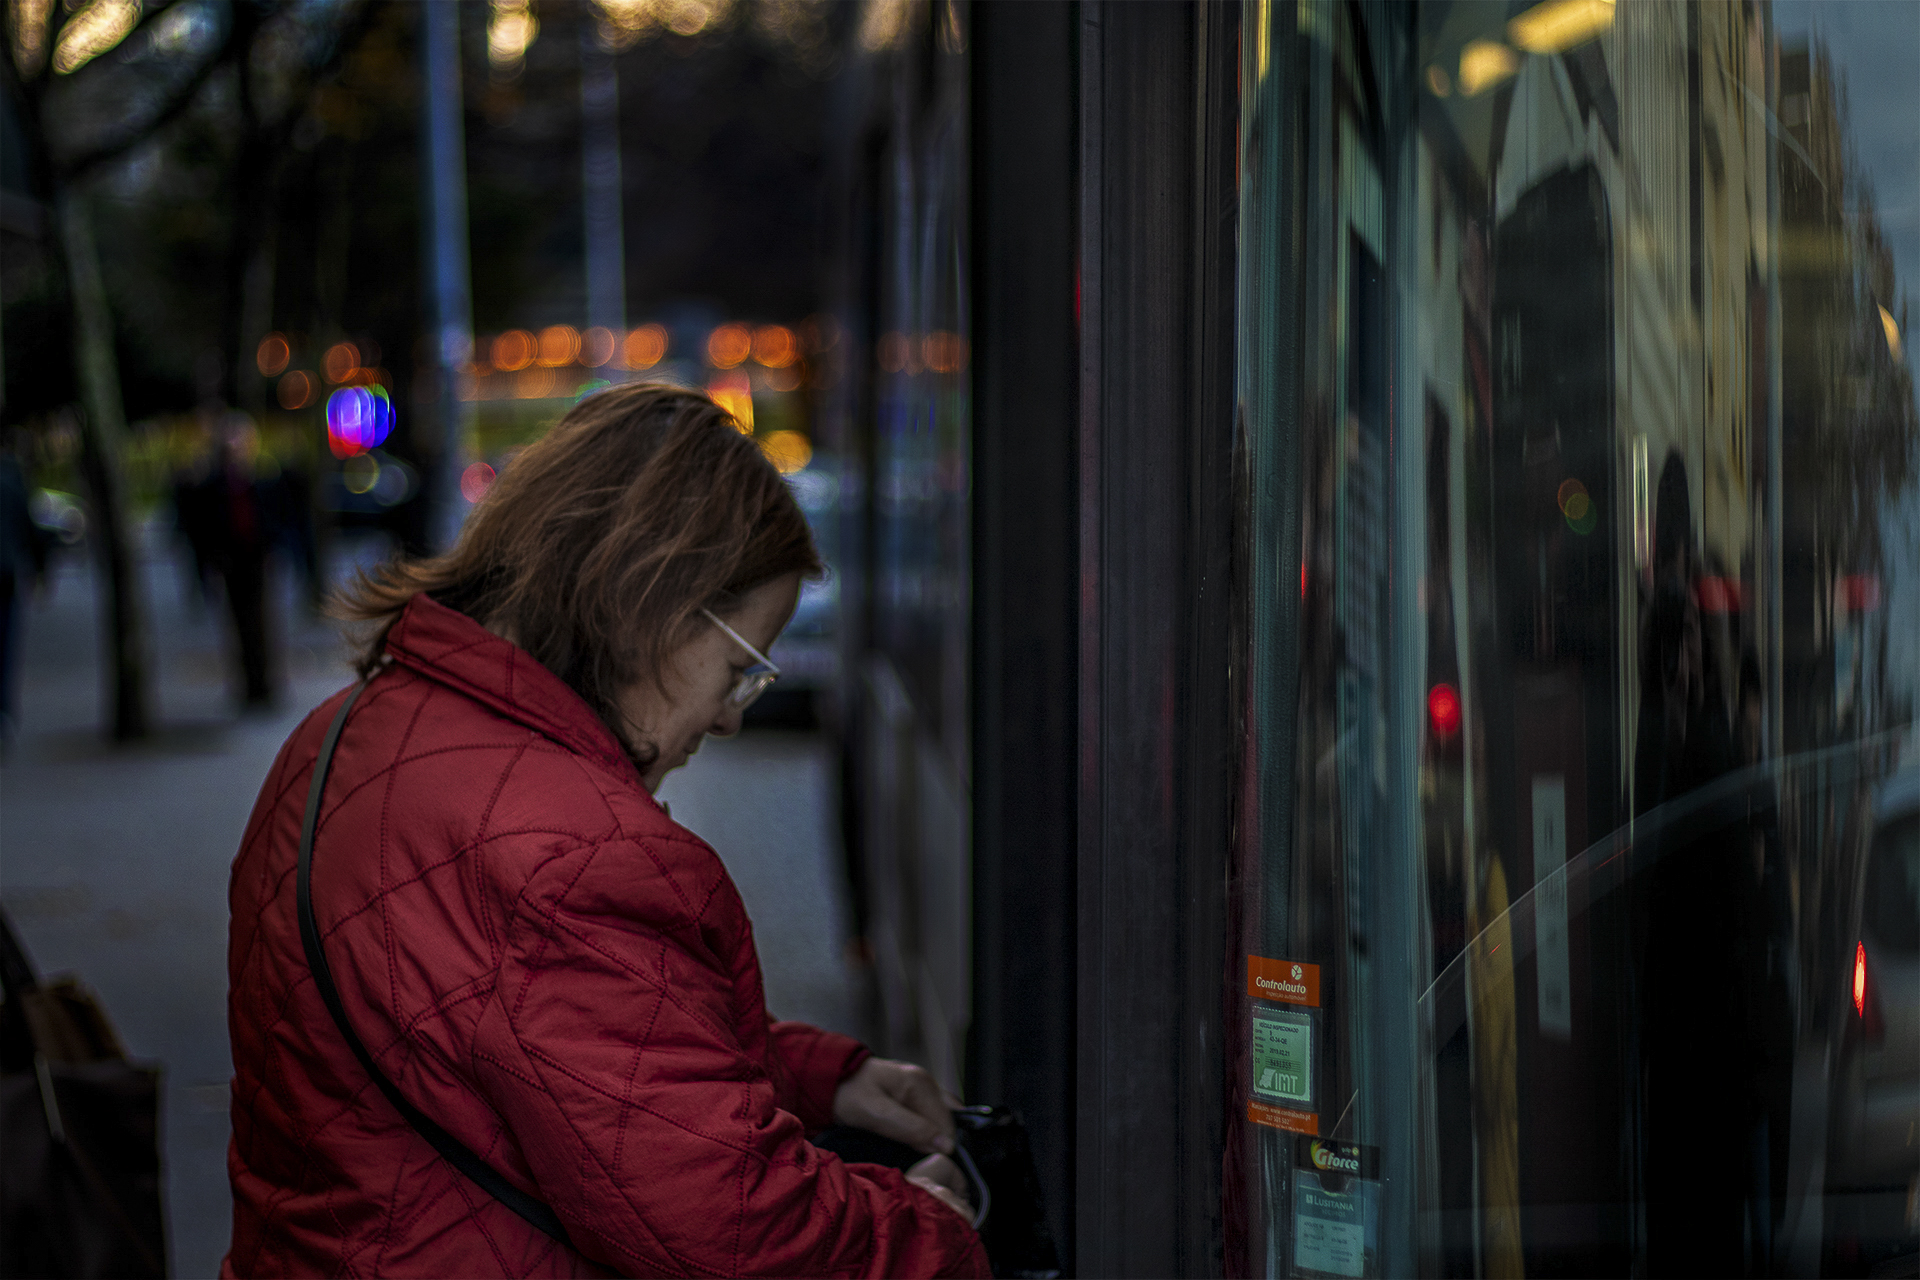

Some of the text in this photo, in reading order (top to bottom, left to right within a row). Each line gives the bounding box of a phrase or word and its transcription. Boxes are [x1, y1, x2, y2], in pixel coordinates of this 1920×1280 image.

[1255, 976, 1307, 994] Controlauto
[1275, 1072, 1298, 1094] IMT
[1314, 1148, 1359, 1171] Gforce
[1314, 1195, 1354, 1212] LUSITANIA
